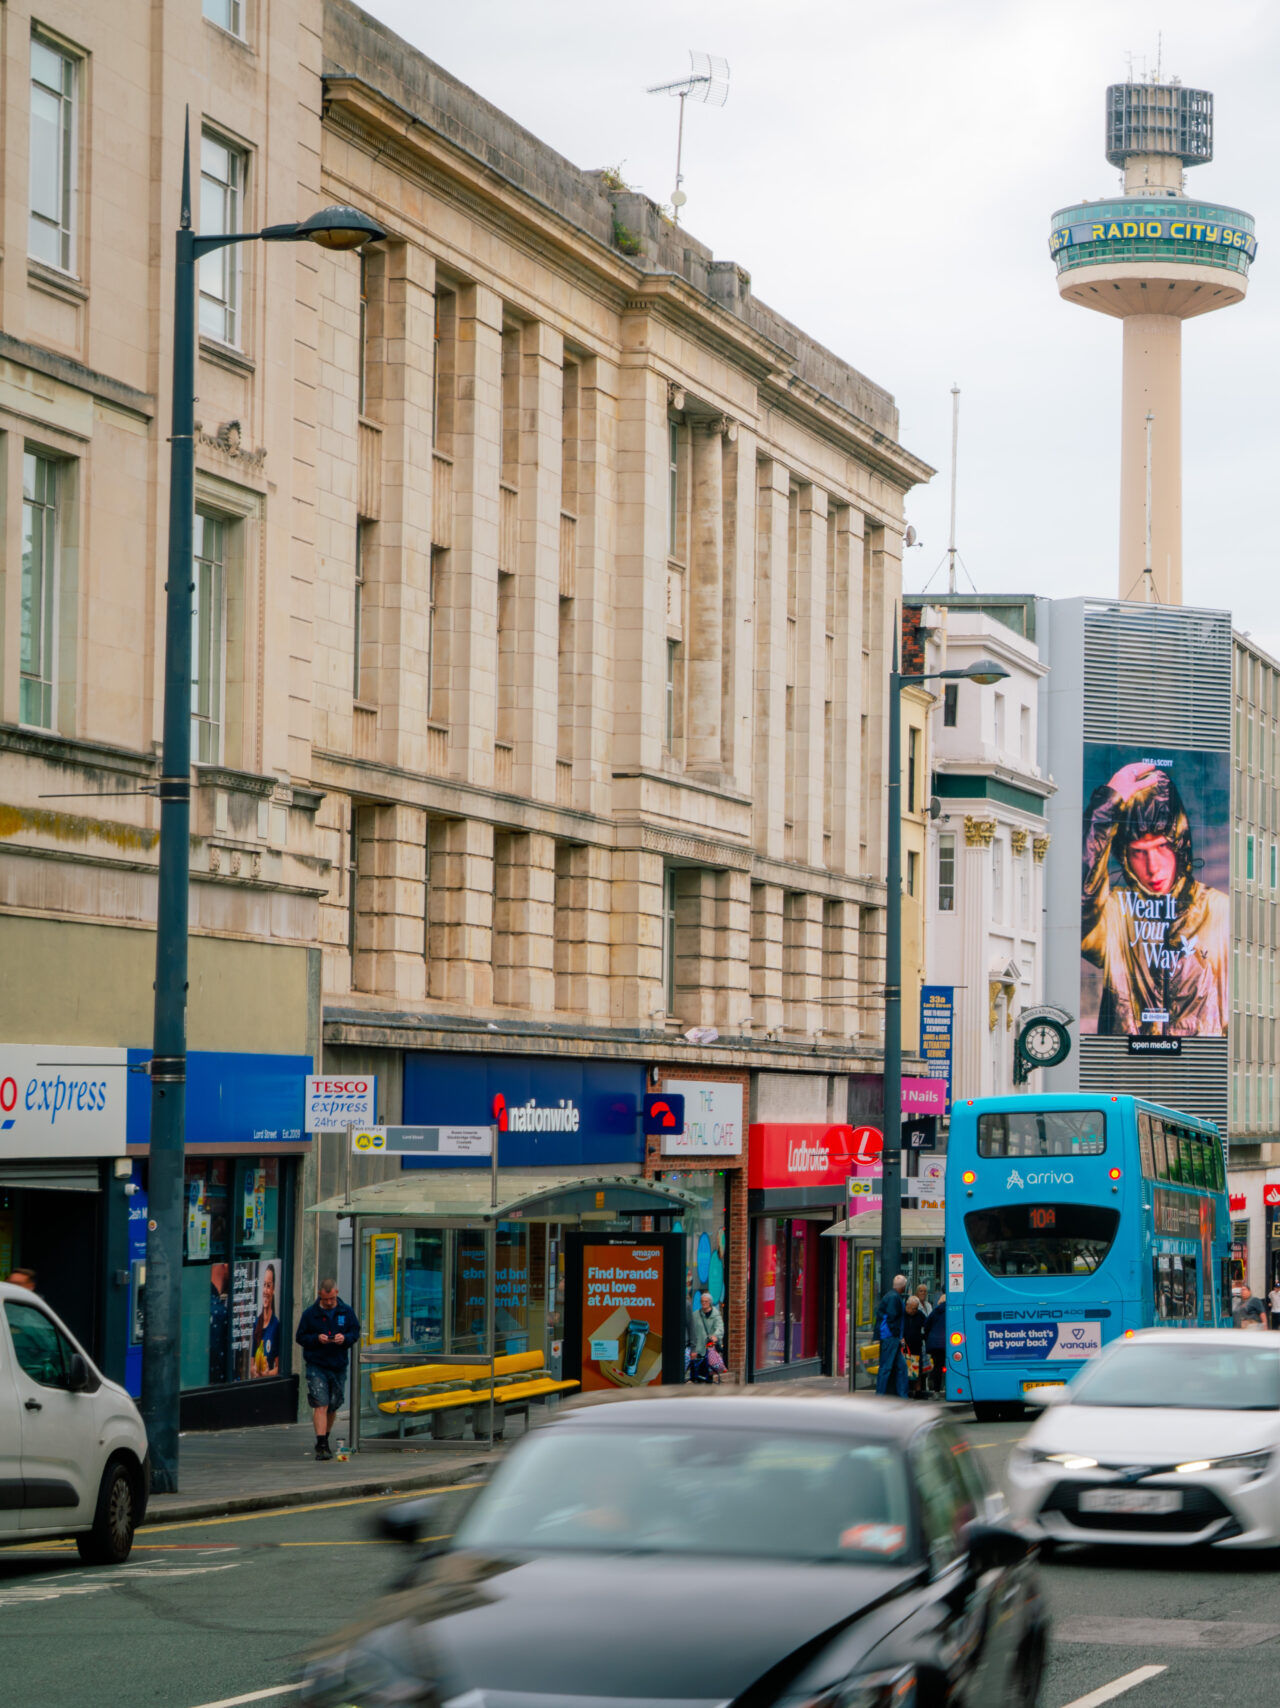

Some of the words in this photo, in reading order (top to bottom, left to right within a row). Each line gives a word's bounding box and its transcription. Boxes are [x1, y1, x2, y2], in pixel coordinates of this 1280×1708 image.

[1092, 222, 1162, 239] RADIO
[1170, 223, 1218, 241] CITY
[1117, 891, 1164, 920] Wear
[1166, 893, 1177, 920] It
[1130, 921, 1170, 947] your
[1143, 942, 1181, 977] Way.
[1132, 1041, 1149, 1050] open
[1150, 1041, 1171, 1049] media
[312, 1081, 368, 1093] TESCO
[24, 1074, 108, 1125] express
[699, 1090, 714, 1112] THE
[909, 1089, 938, 1104] Nails
[311, 1100, 368, 1115] express
[314, 1116, 338, 1127] 24hr
[340, 1116, 365, 1127] cash
[508, 1099, 580, 1132] nationwide
[253, 1129, 264, 1139] Lord
[265, 1129, 277, 1139] Street
[912, 1132, 925, 1147] 27
[787, 1140, 830, 1173] Ladbrokes
[1027, 1170, 1074, 1185] arriva
[632, 1249, 660, 1258] amazon
[234, 1268, 248, 1280] erving
[588, 1267, 614, 1280] Find
[616, 1267, 659, 1280] brands
[233, 1280, 243, 1290] ord
[588, 1283, 610, 1294] you
[611, 1282, 636, 1293] love
[588, 1295, 601, 1307] at
[603, 1295, 655, 1307] Amazon.
[1002, 1310, 1063, 1320] ENVIRO
[988, 1330, 1004, 1338] The
[1004, 1330, 1027, 1338] bank
[1028, 1329, 1054, 1338] that's
[988, 1340, 1004, 1349] got
[1005, 1340, 1025, 1349] your
[1026, 1339, 1048, 1347] back
[1060, 1340, 1098, 1351] vanquis
